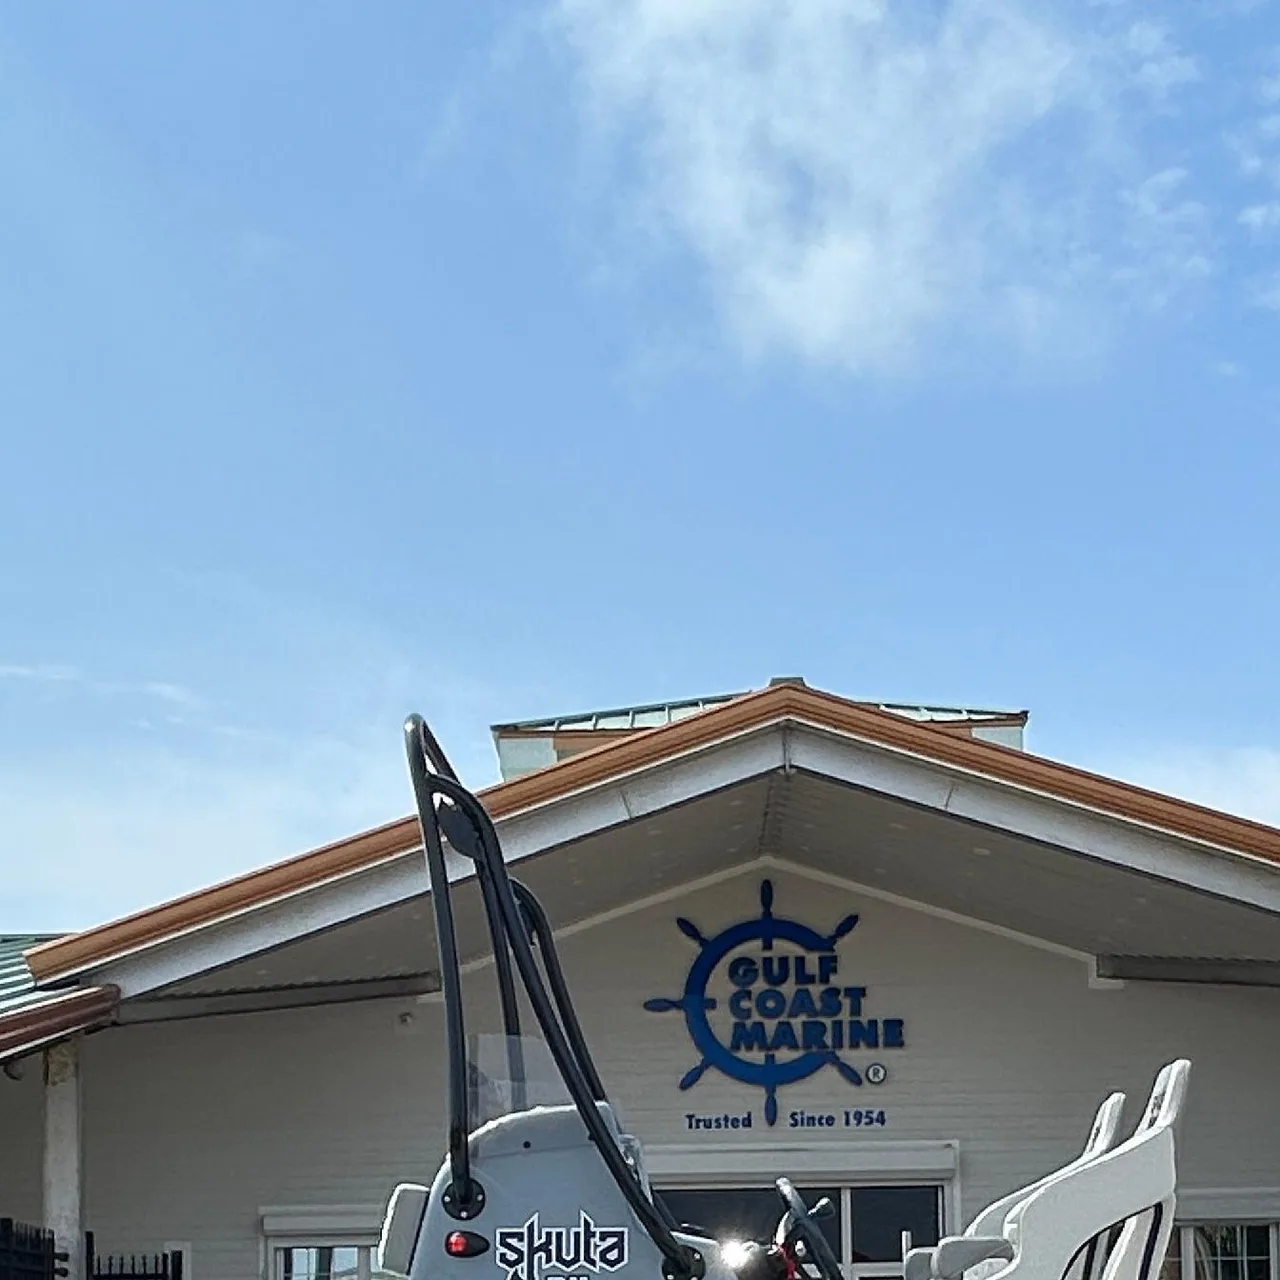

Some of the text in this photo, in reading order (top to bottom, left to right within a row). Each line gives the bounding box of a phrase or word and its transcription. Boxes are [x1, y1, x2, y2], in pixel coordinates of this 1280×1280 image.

[728, 955, 838, 987] GULF
[728, 987, 867, 1019] COAST
[729, 1019, 905, 1051] MARINE
[685, 1110, 886, 1129] Trusted Since 1954
